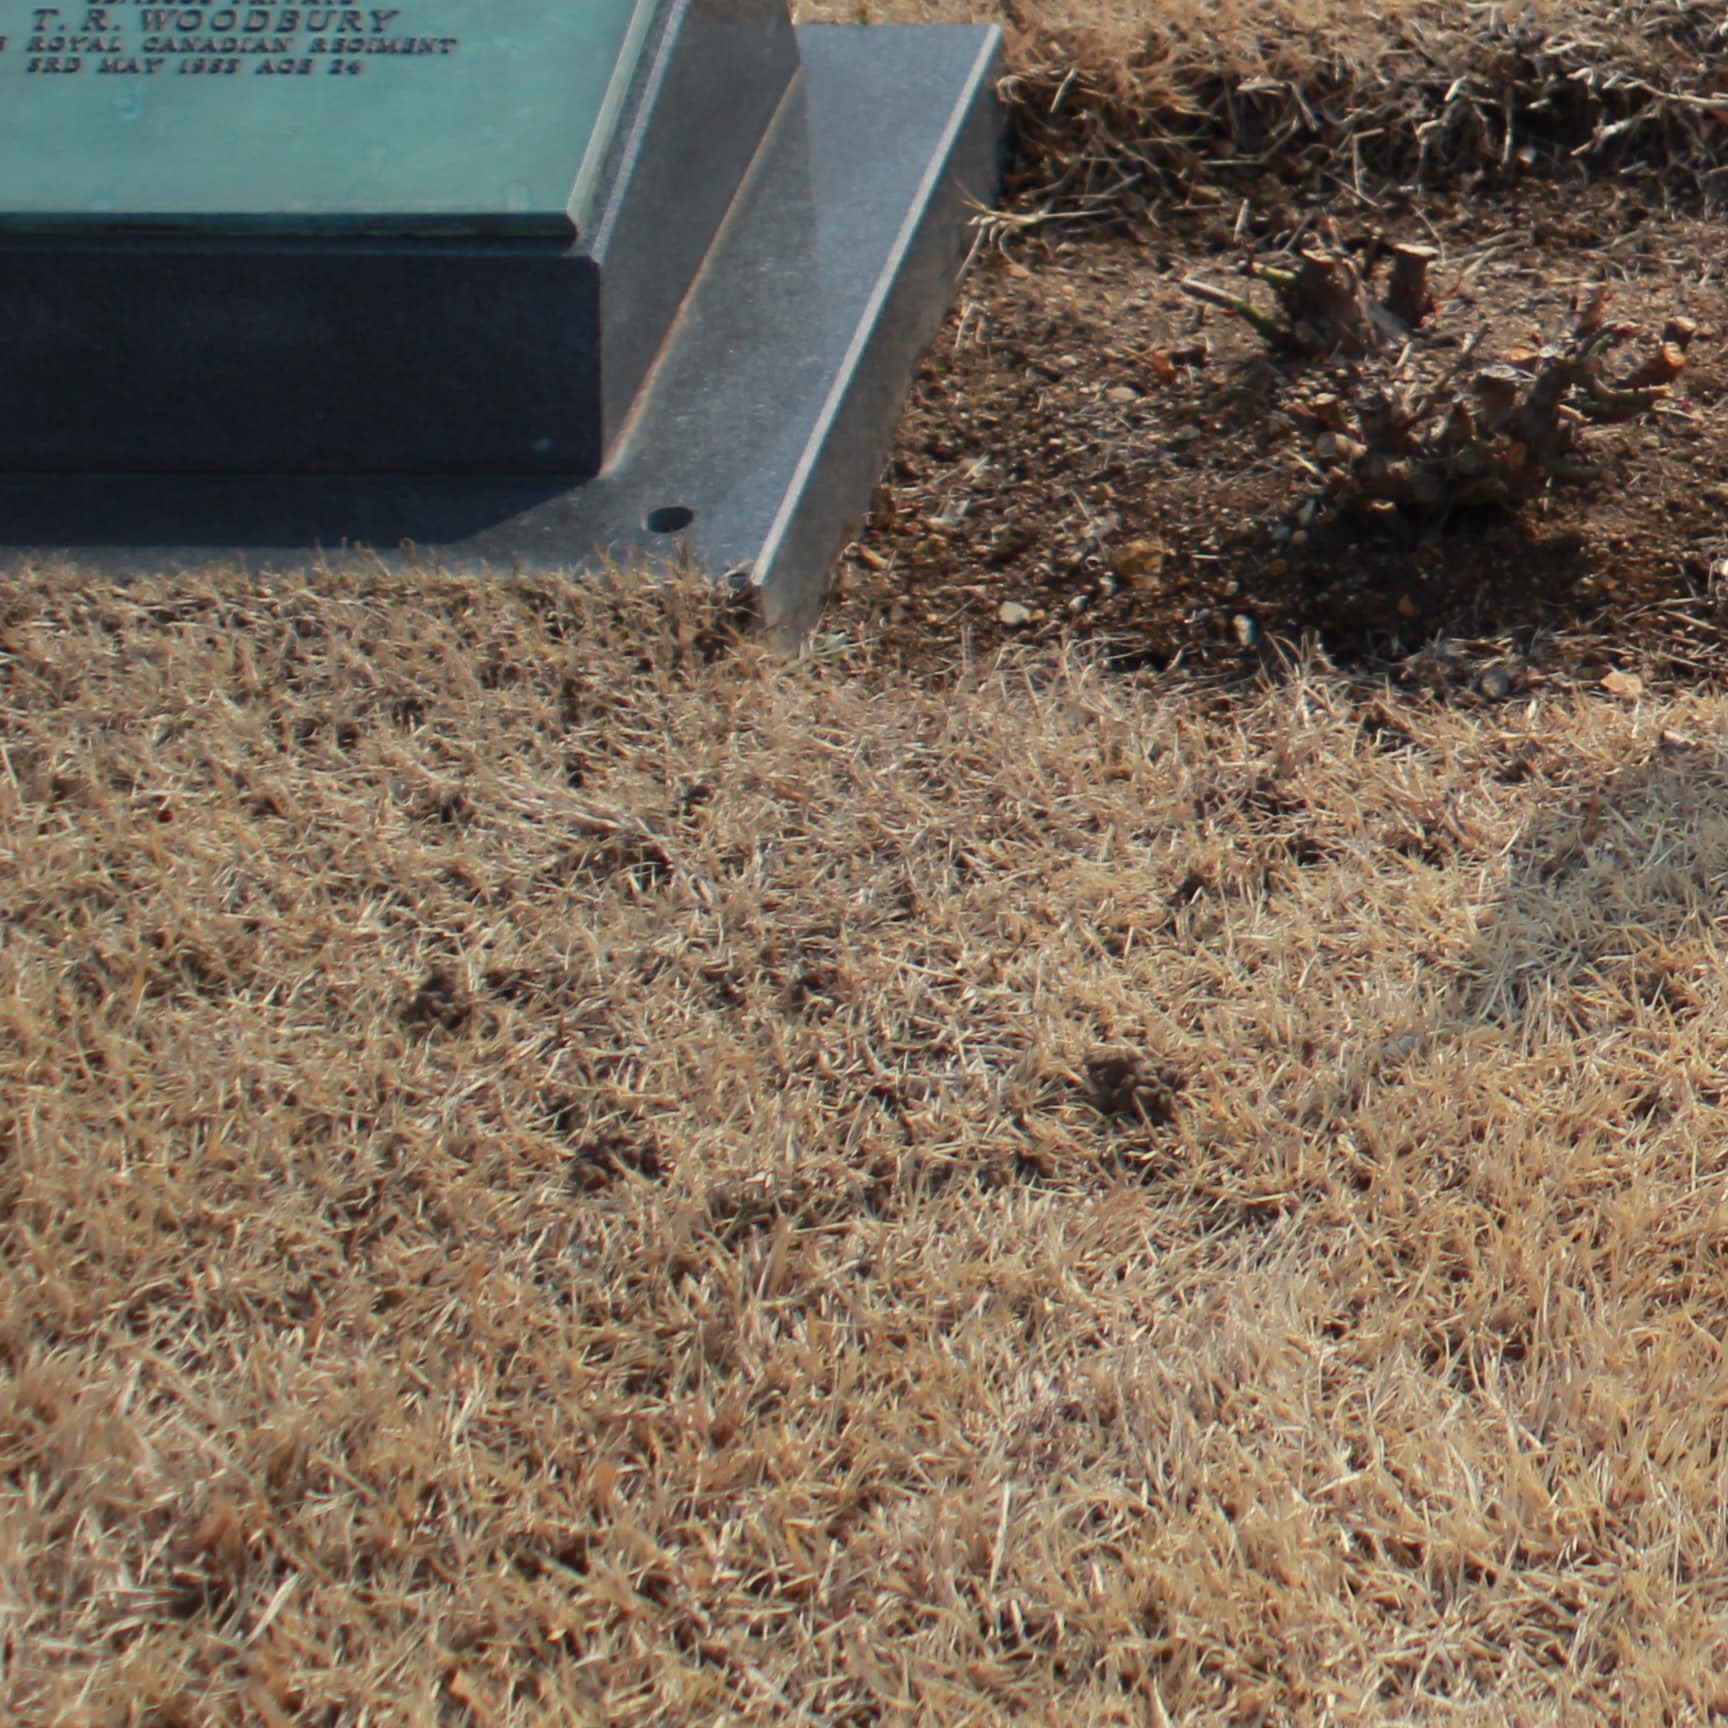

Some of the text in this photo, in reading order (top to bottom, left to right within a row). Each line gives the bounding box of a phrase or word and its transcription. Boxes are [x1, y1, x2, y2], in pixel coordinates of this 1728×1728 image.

[141, 8, 400, 33] WOODBURY
[26, 35, 122, 53] ROYAL
[141, 35, 294, 54] CANADIAN
[308, 36, 458, 55] REGIMENT
[97, 57, 165, 75] MAY
[255, 57, 313, 76] AGE
